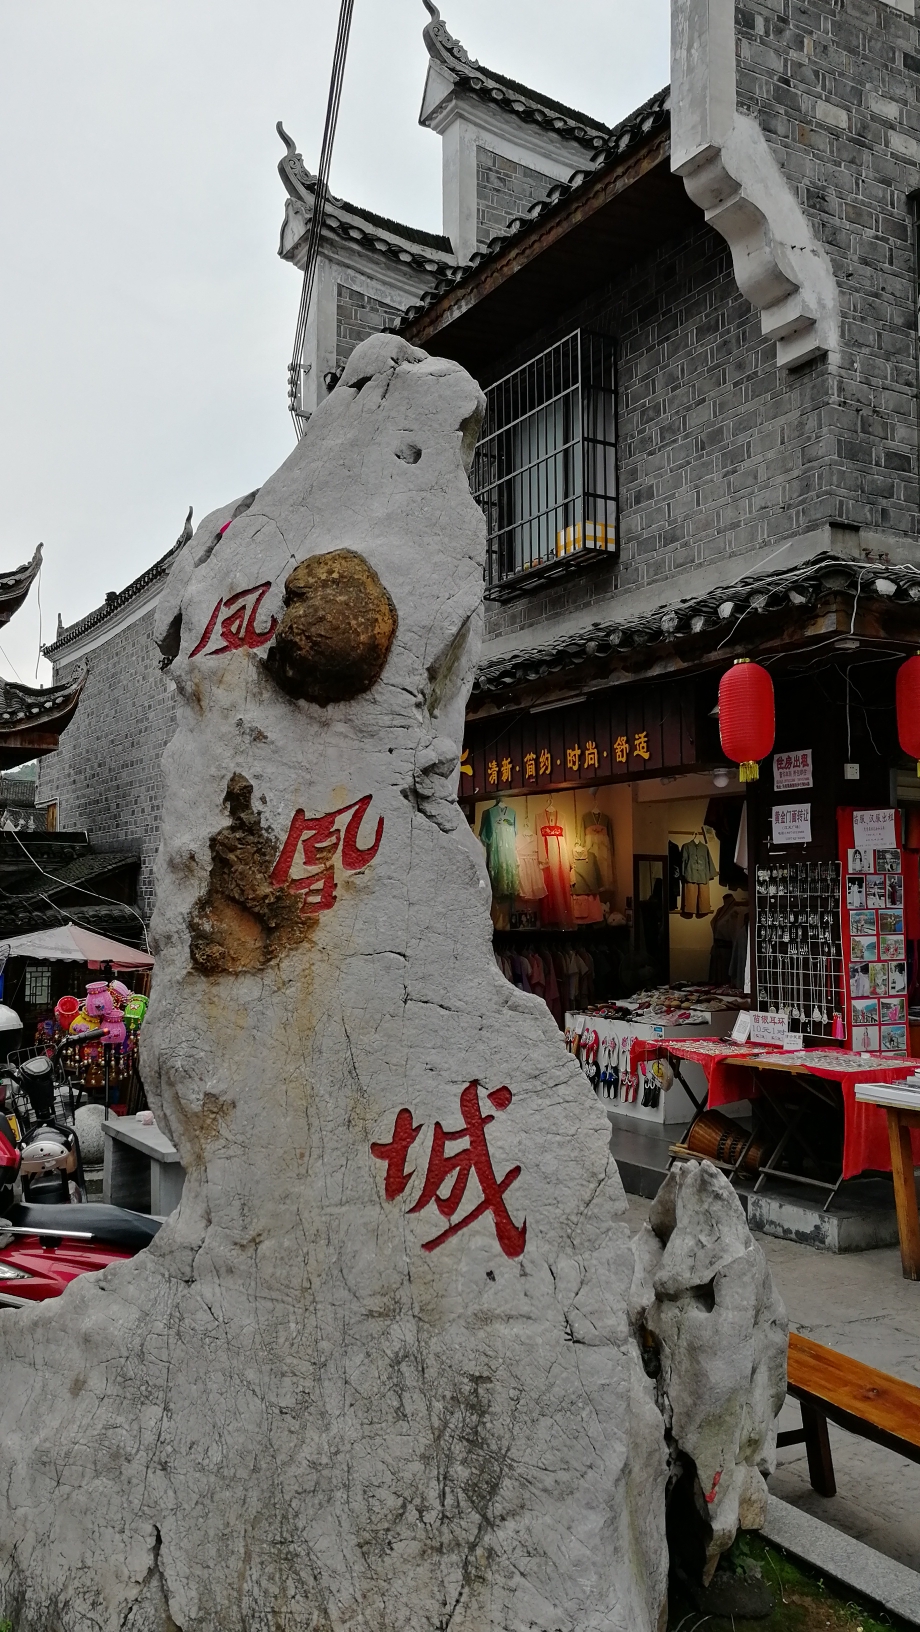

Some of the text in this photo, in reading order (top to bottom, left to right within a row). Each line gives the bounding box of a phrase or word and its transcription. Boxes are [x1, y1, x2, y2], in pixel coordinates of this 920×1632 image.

[776, 753, 809, 771] 住房出租
[774, 808, 809, 825] 黄金门面转让
